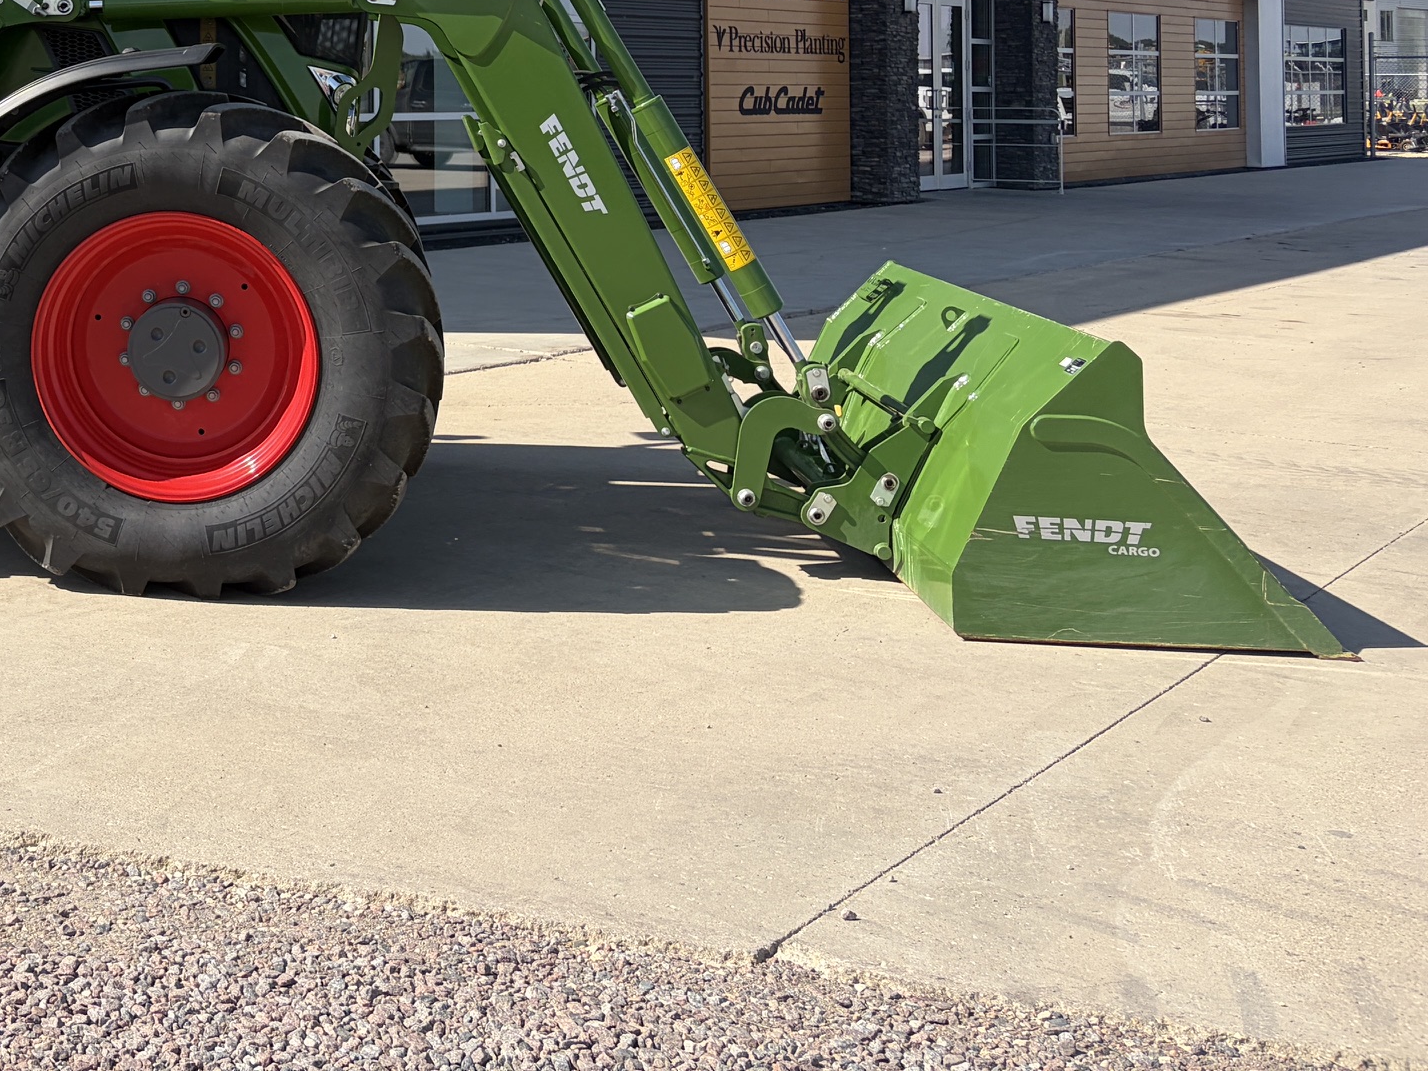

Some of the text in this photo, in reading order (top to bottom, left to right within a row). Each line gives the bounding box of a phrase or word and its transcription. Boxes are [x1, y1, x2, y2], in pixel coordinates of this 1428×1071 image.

[728, 27, 846, 63] Precision Planting
[739, 85, 825, 116] Cub Cadet
[539, 113, 608, 215] FENDT
[7, 163, 136, 264] MICHELIN
[211, 451, 348, 555] MICHELIN
[1012, 515, 1152, 545] FENDT
[1108, 545, 1160, 557] CARGO
